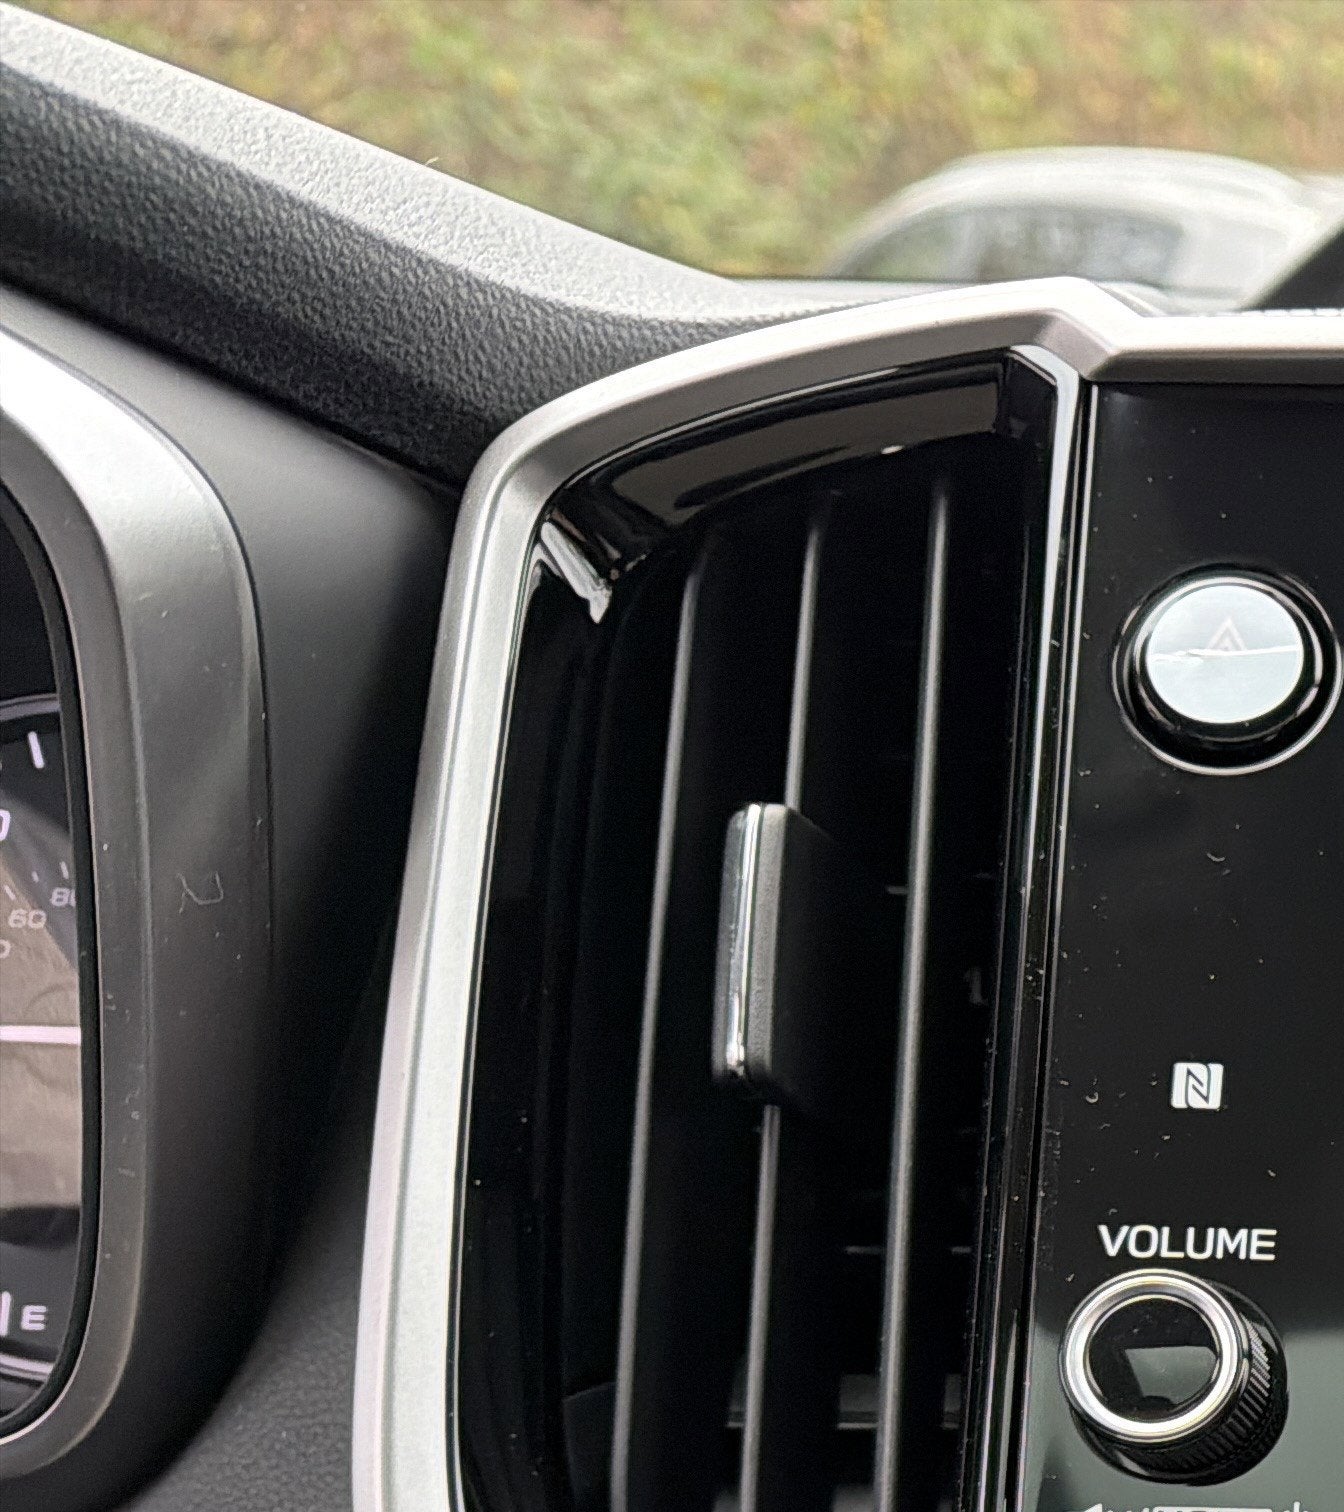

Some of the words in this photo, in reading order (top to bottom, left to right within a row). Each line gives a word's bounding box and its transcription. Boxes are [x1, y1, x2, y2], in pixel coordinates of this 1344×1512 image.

[8, 908, 47, 929] 60
[1098, 1224, 1278, 1261] VOLUME
[20, 1304, 47, 1331] E
